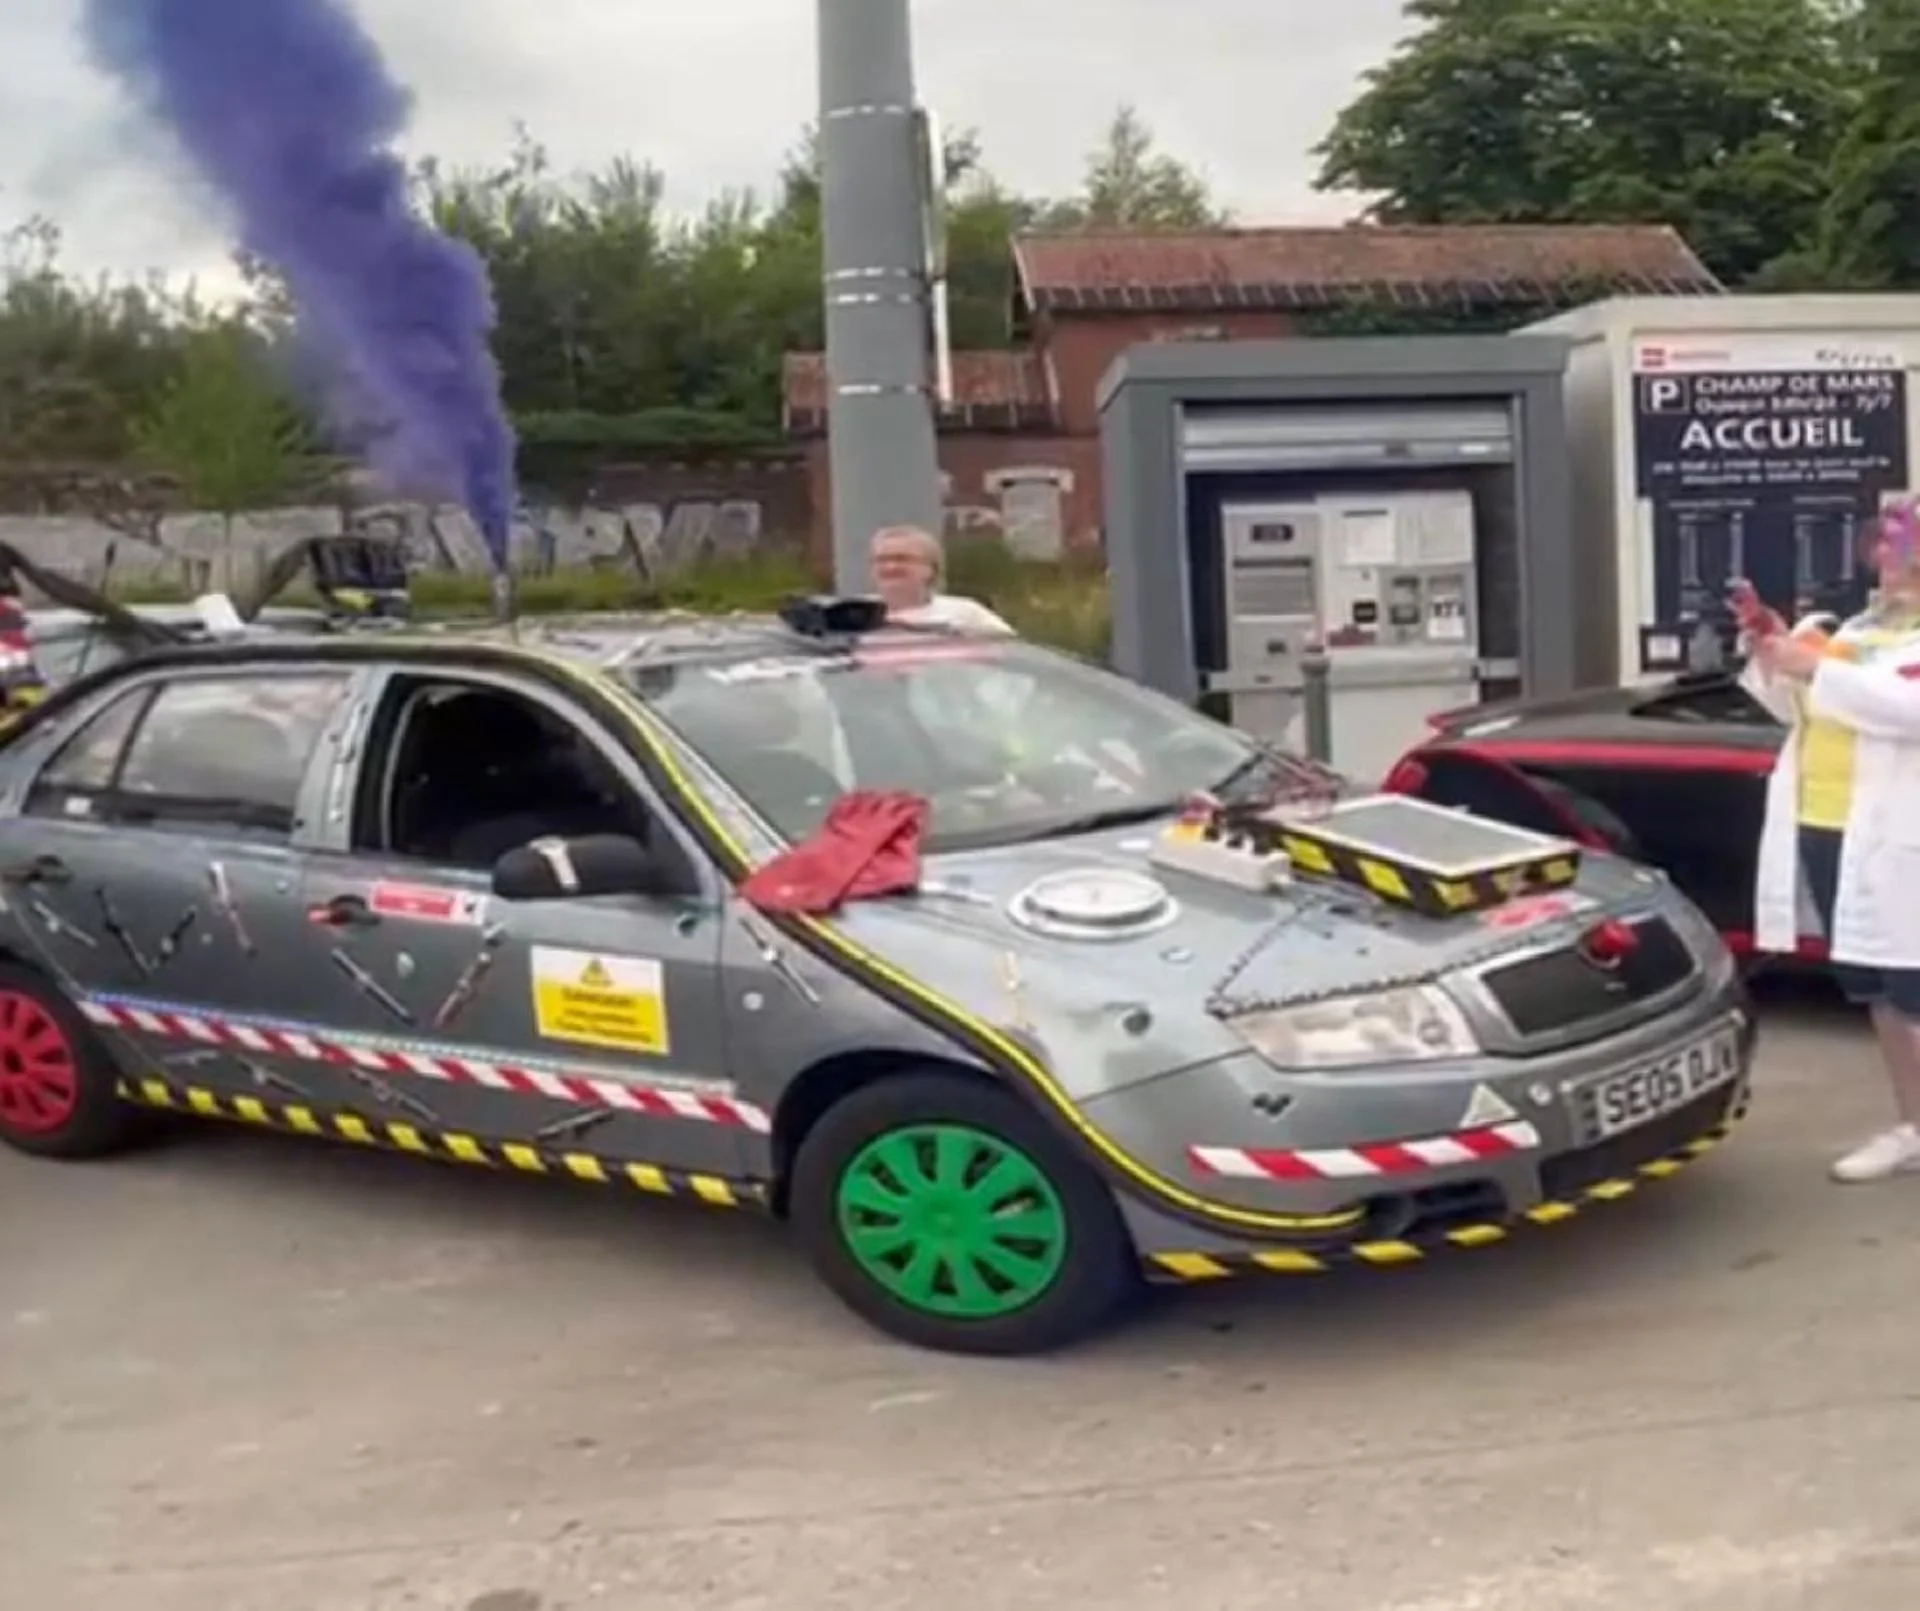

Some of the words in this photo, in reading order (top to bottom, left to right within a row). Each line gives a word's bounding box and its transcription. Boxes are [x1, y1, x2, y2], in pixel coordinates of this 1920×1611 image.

[1651, 378, 1679, 412] P
[1695, 376, 1783, 392] CHAMP
[1788, 375, 1819, 391] DE
[1827, 374, 1894, 391] MARS
[1680, 418, 1864, 451] ACCUEIL
